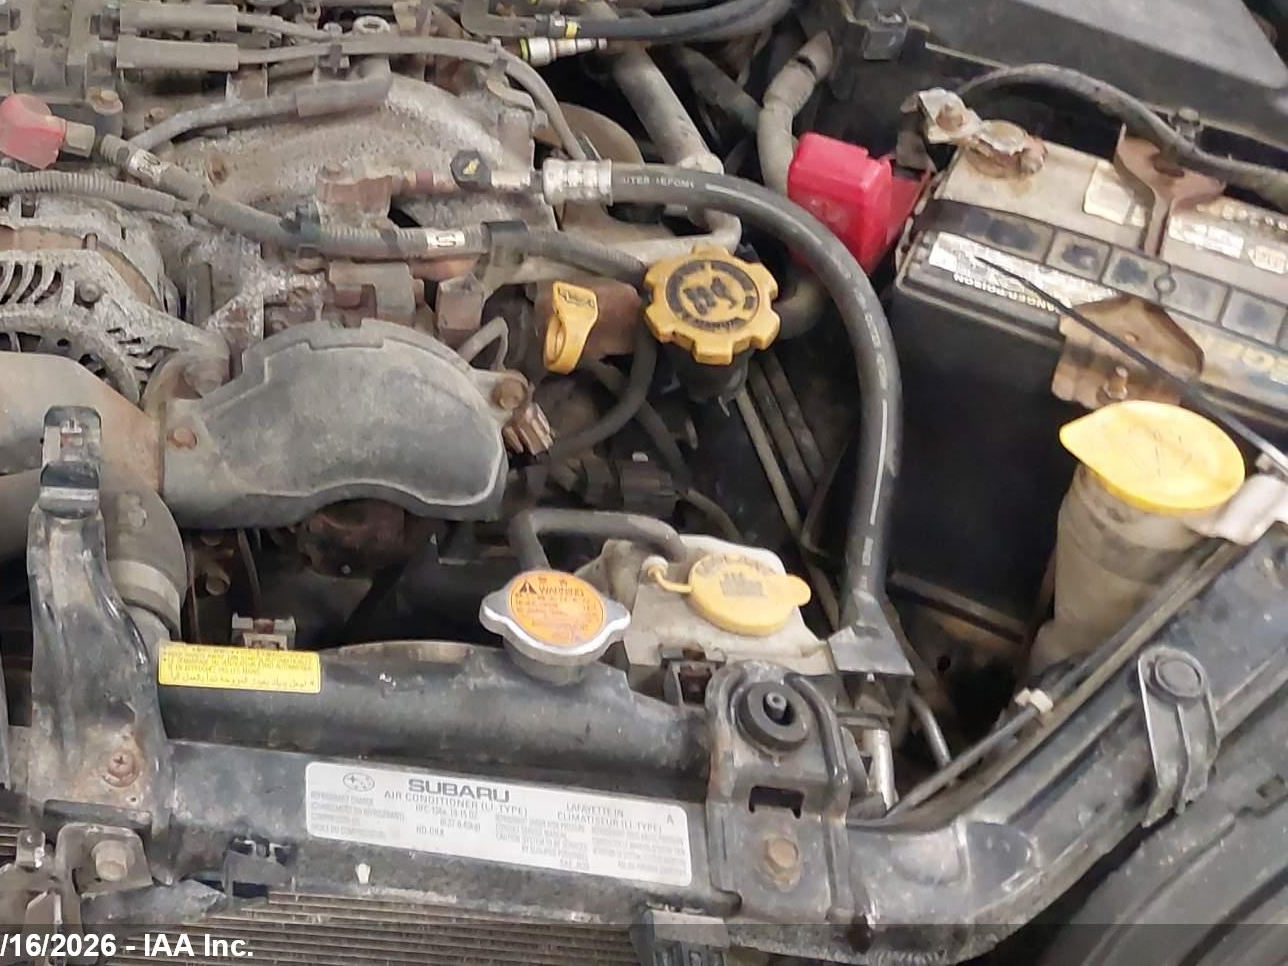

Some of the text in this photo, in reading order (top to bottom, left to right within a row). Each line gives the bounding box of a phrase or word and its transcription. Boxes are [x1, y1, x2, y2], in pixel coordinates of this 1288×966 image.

[383, 789, 402, 801] AIR
[405, 792, 479, 811] CONDITIONER
[408, 778, 510, 803] SUBARU
